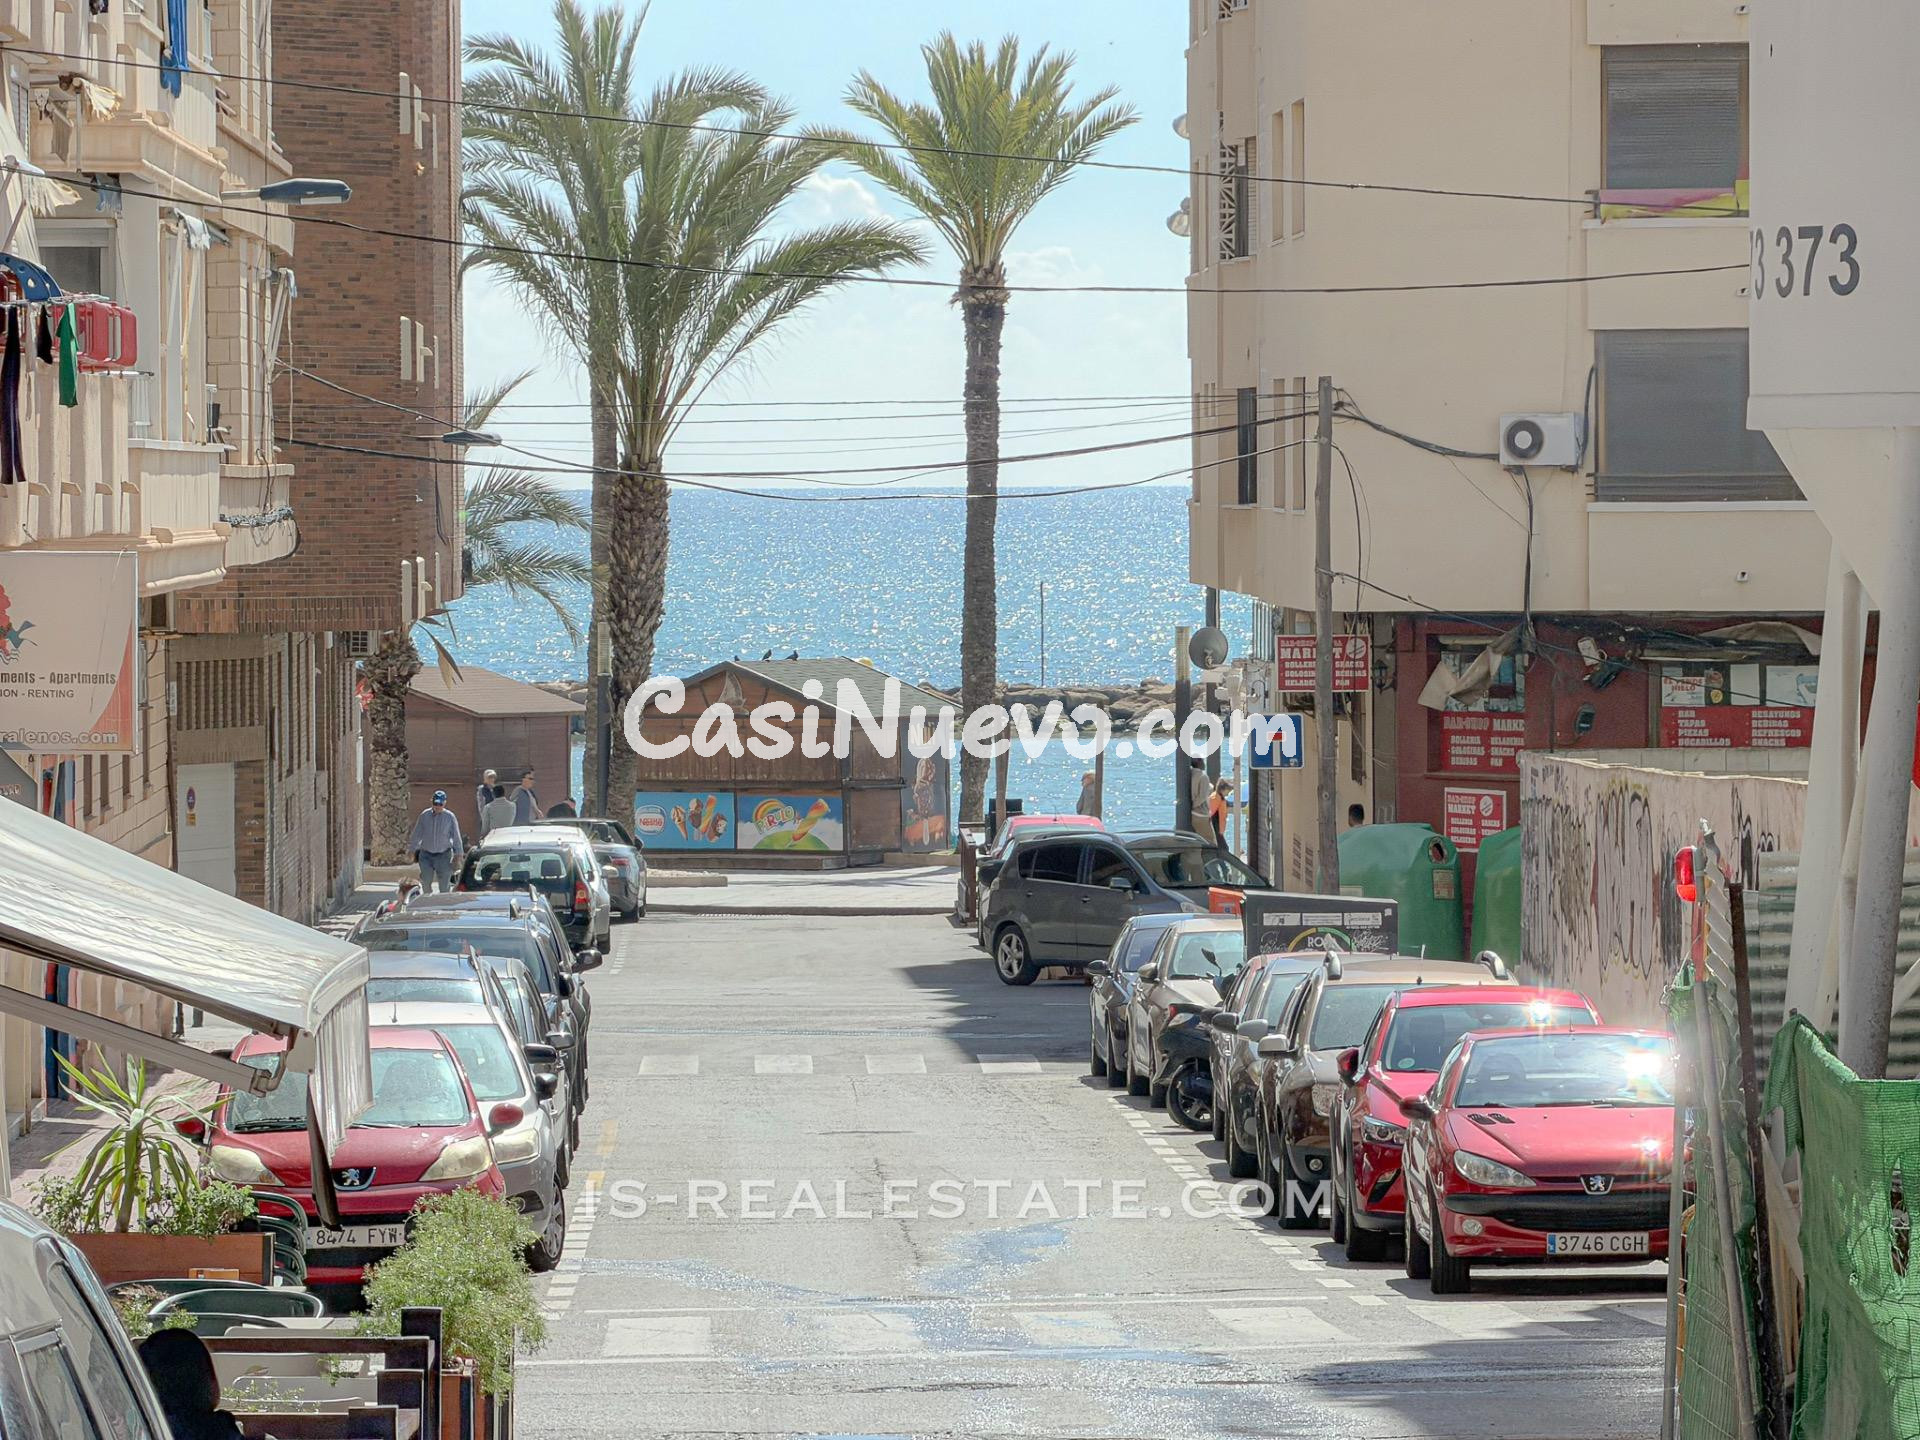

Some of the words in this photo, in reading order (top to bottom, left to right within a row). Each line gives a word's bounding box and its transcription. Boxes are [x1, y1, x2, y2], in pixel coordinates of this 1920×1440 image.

[1775, 223, 1860, 298] 373
[1280, 647, 1342, 658] MART
[49, 672, 116, 684] Apartments
[28, 690, 74, 698] RENTING
[1558, 1235, 1604, 1252] 3746
[1610, 1235, 1644, 1252] CGH
